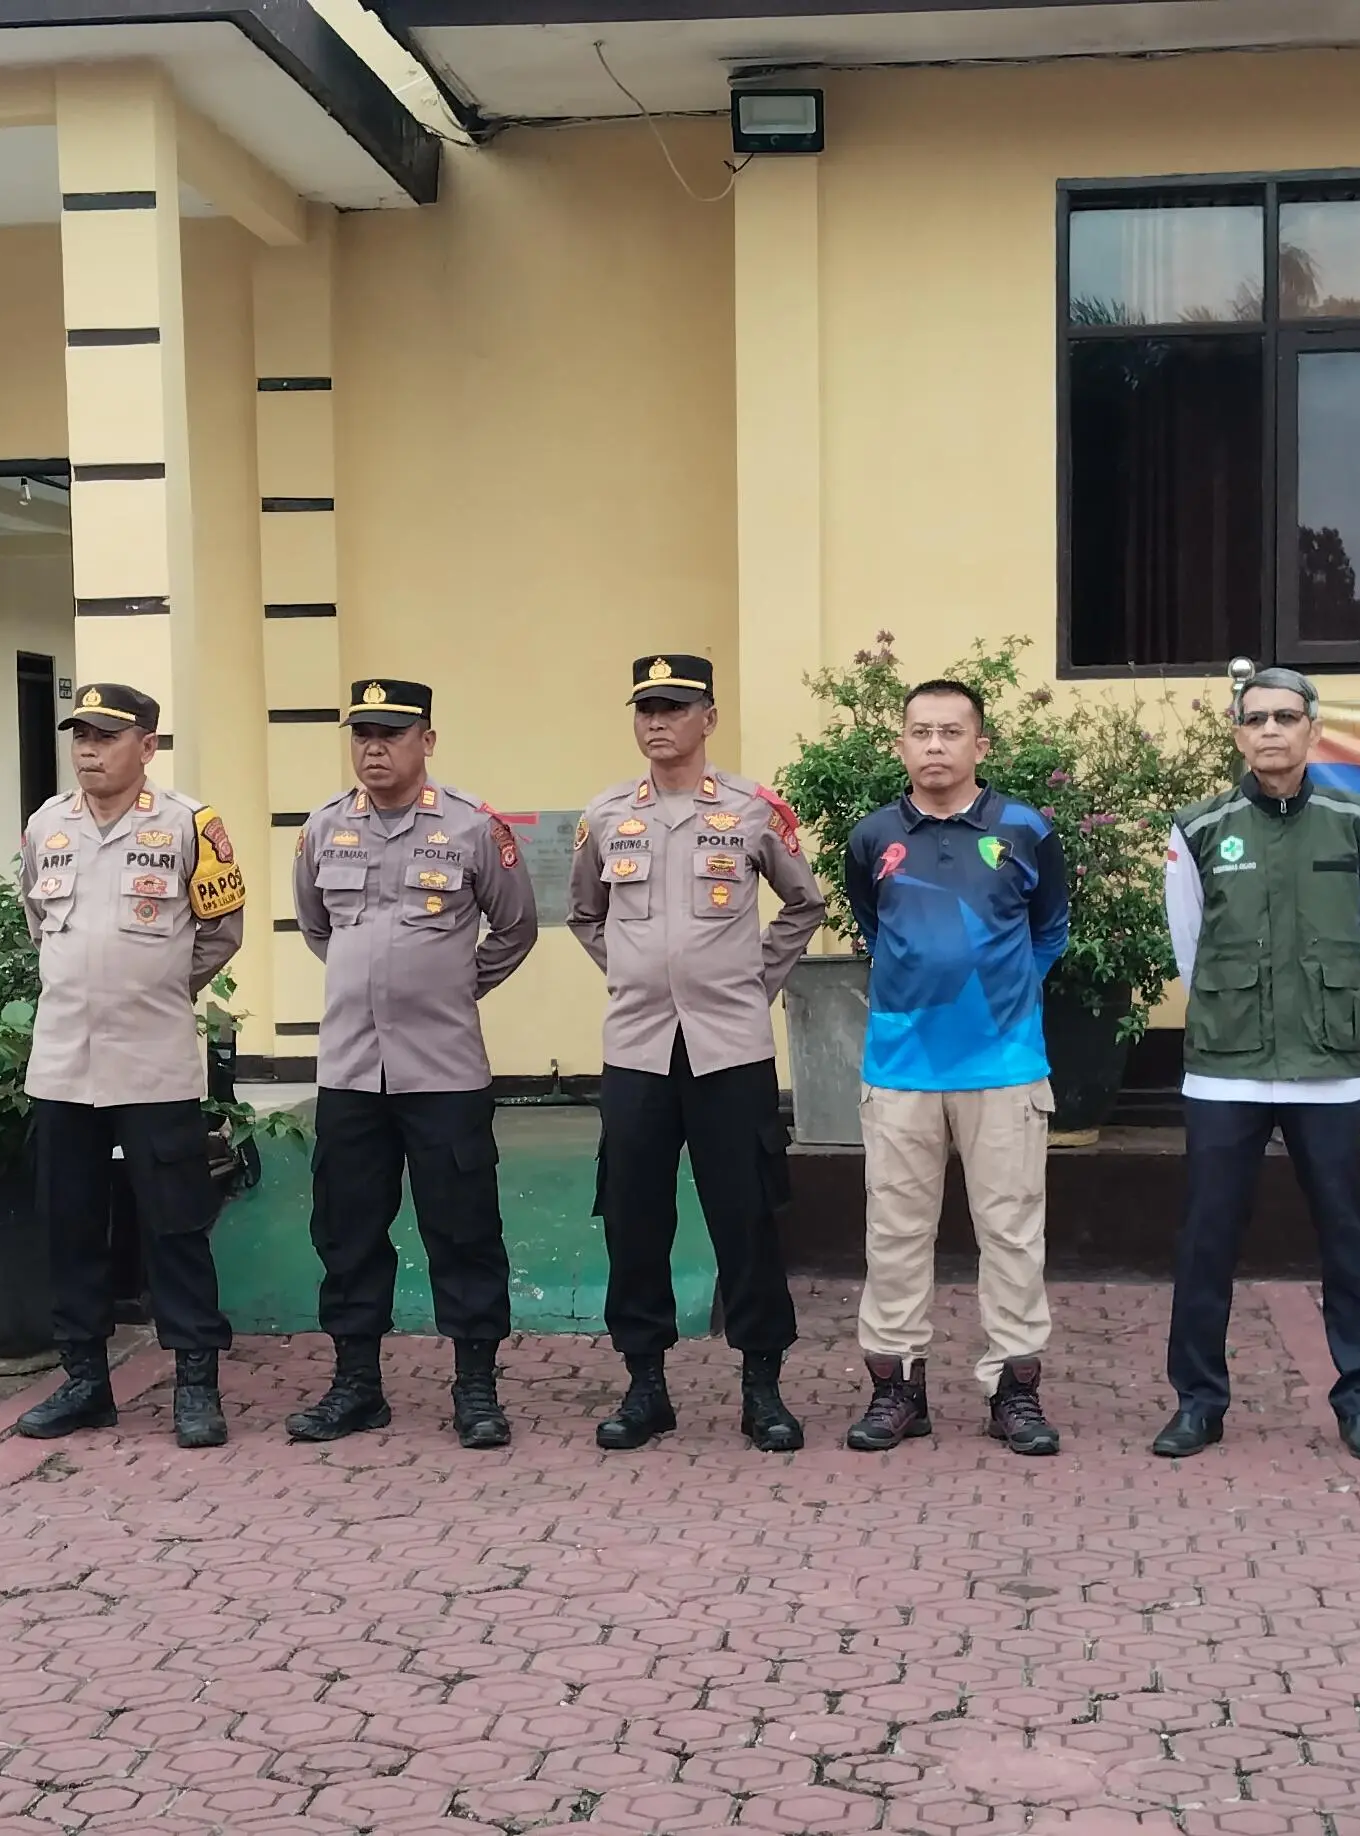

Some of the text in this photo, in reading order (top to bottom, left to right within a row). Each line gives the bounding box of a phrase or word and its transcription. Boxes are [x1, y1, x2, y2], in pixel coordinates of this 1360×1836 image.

[697, 835, 745, 848] POLRI
[41, 853, 74, 869] ARIF
[126, 852, 176, 870] POLRI
[413, 848, 461, 863] POLRI
